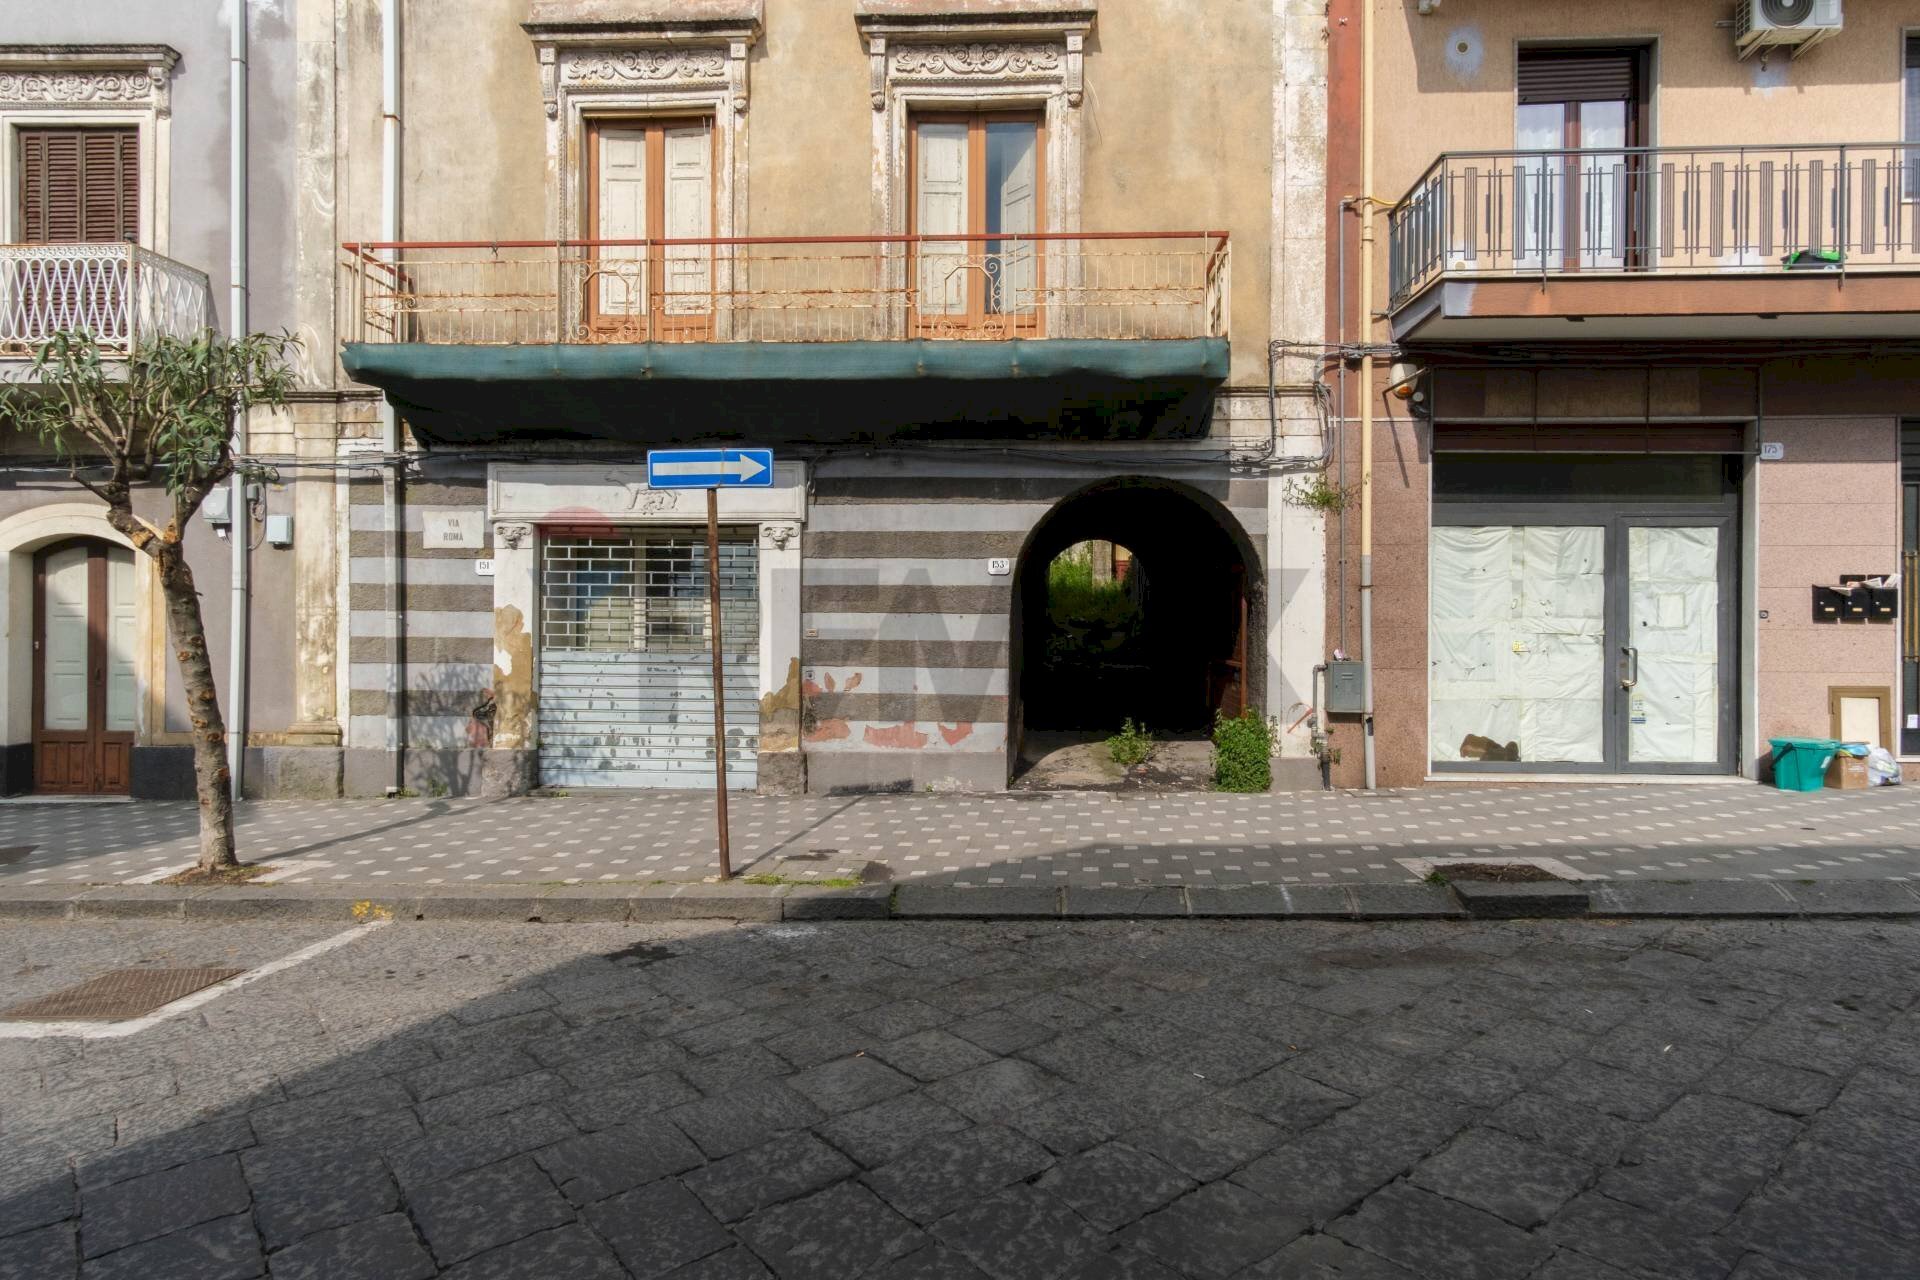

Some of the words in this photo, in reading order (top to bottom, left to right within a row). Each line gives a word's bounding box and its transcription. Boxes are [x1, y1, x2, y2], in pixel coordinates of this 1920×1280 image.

[448, 519, 460, 528] VIA
[443, 533, 464, 542] ROMA
[479, 561, 490, 570] 151
